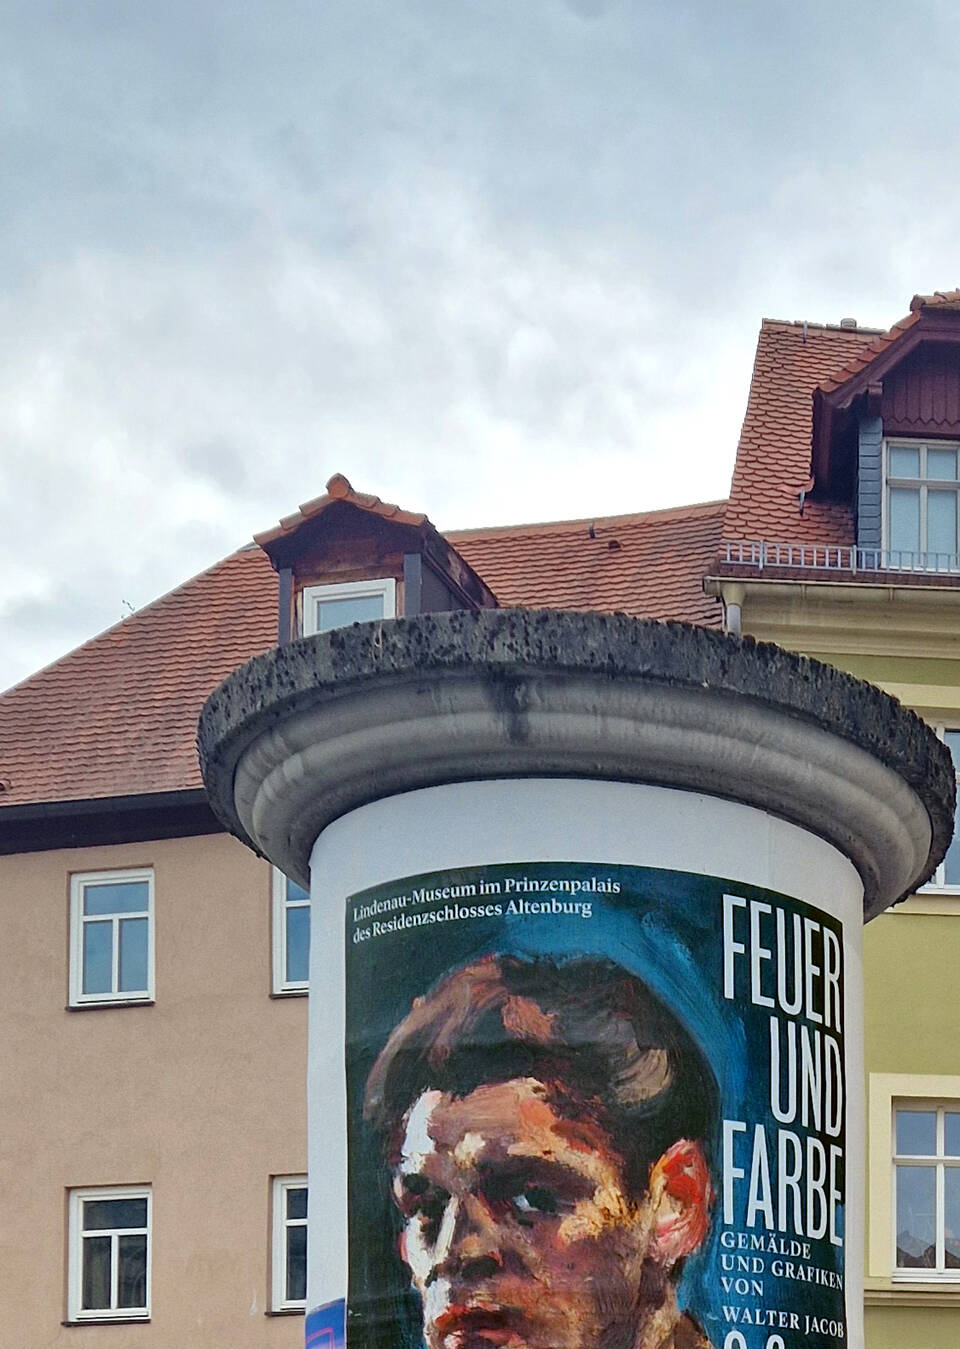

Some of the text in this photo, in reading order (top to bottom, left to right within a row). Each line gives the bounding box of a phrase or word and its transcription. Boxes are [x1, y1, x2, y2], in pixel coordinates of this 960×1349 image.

[353, 877, 620, 922] Lindenau-Museum im Prinzenpalais
[353, 898, 592, 943] des Residenzschlosses Altenburg
[723, 894, 841, 1033] FEUER
[770, 1016, 843, 1137] UND
[722, 1119, 843, 1247] FARBE
[720, 1231, 812, 1260] GEMÄLDE
[721, 1254, 843, 1292] UND GRAFIKEN
[721, 1277, 764, 1297] VON
[722, 1306, 844, 1338] WALTER JACOB
